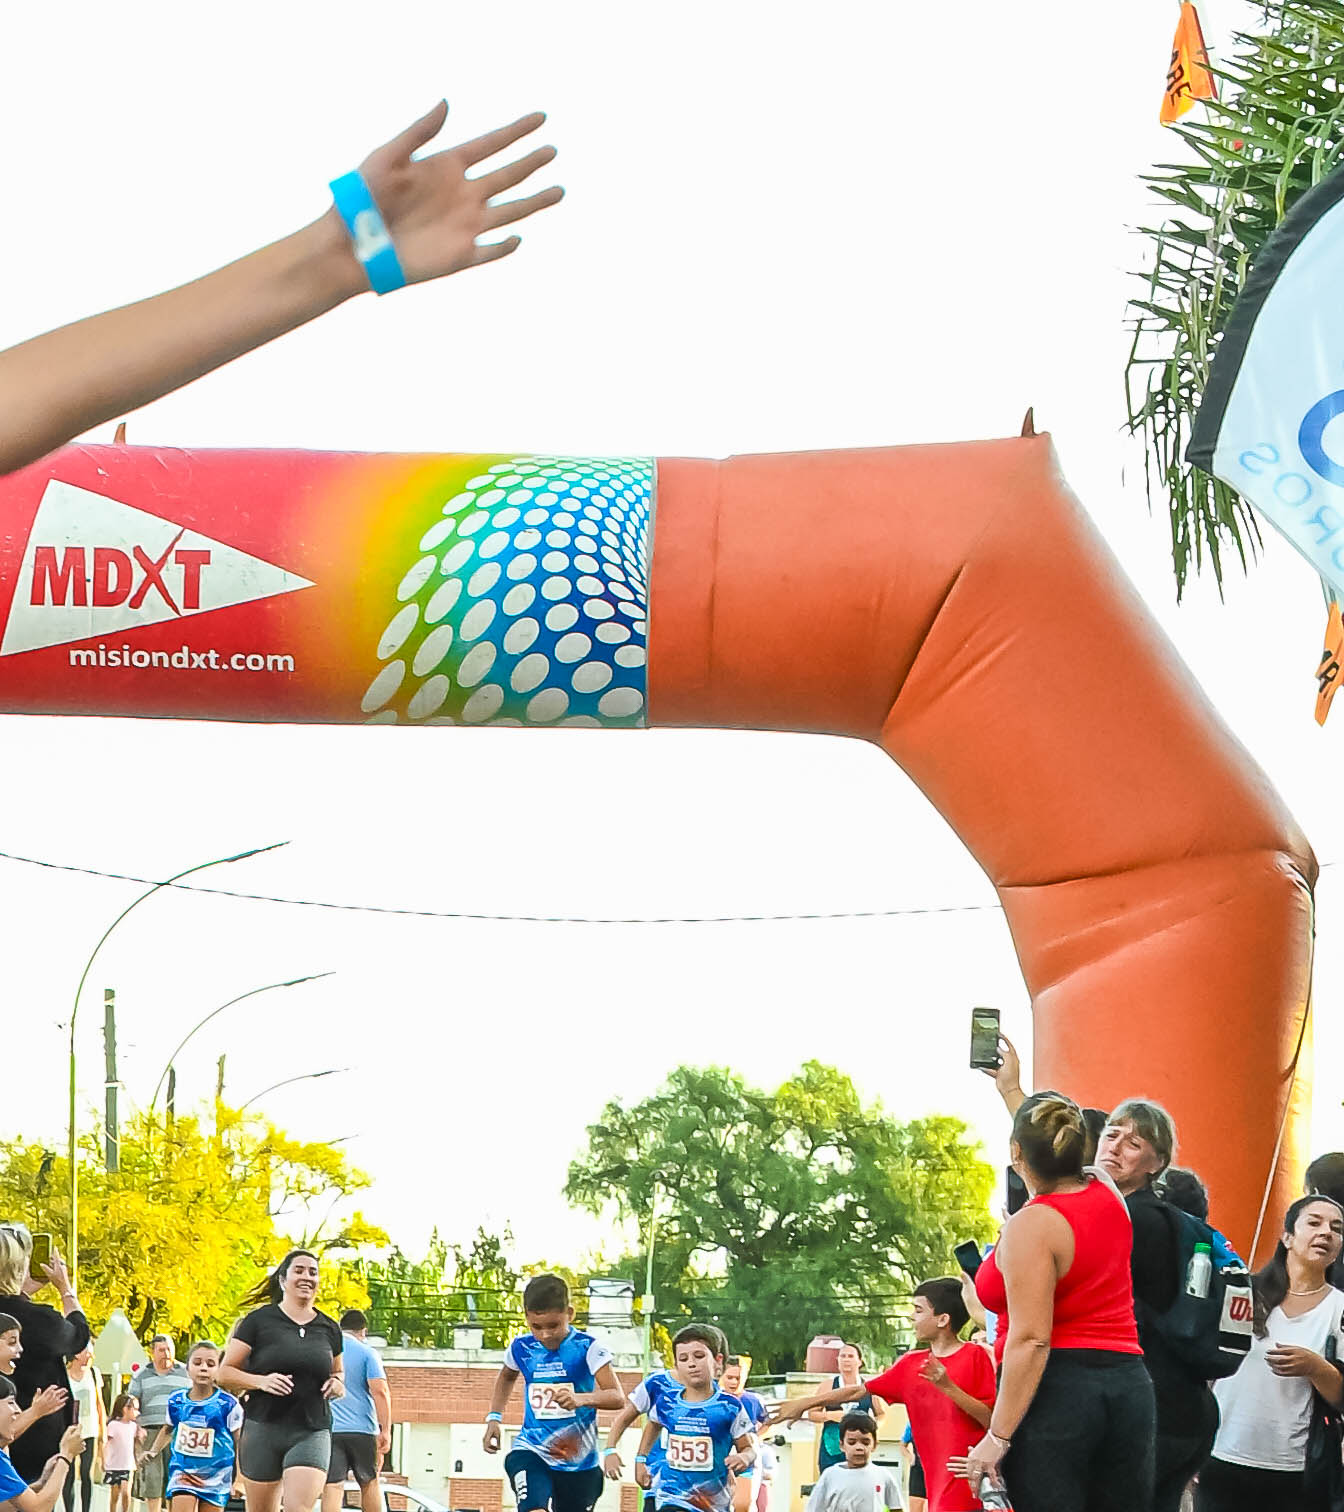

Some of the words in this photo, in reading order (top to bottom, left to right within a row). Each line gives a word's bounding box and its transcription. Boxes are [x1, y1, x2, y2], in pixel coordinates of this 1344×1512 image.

[29, 526, 211, 616] MDXT
[69, 645, 295, 674] misiondxt.com
[670, 1438, 709, 1465] 553
